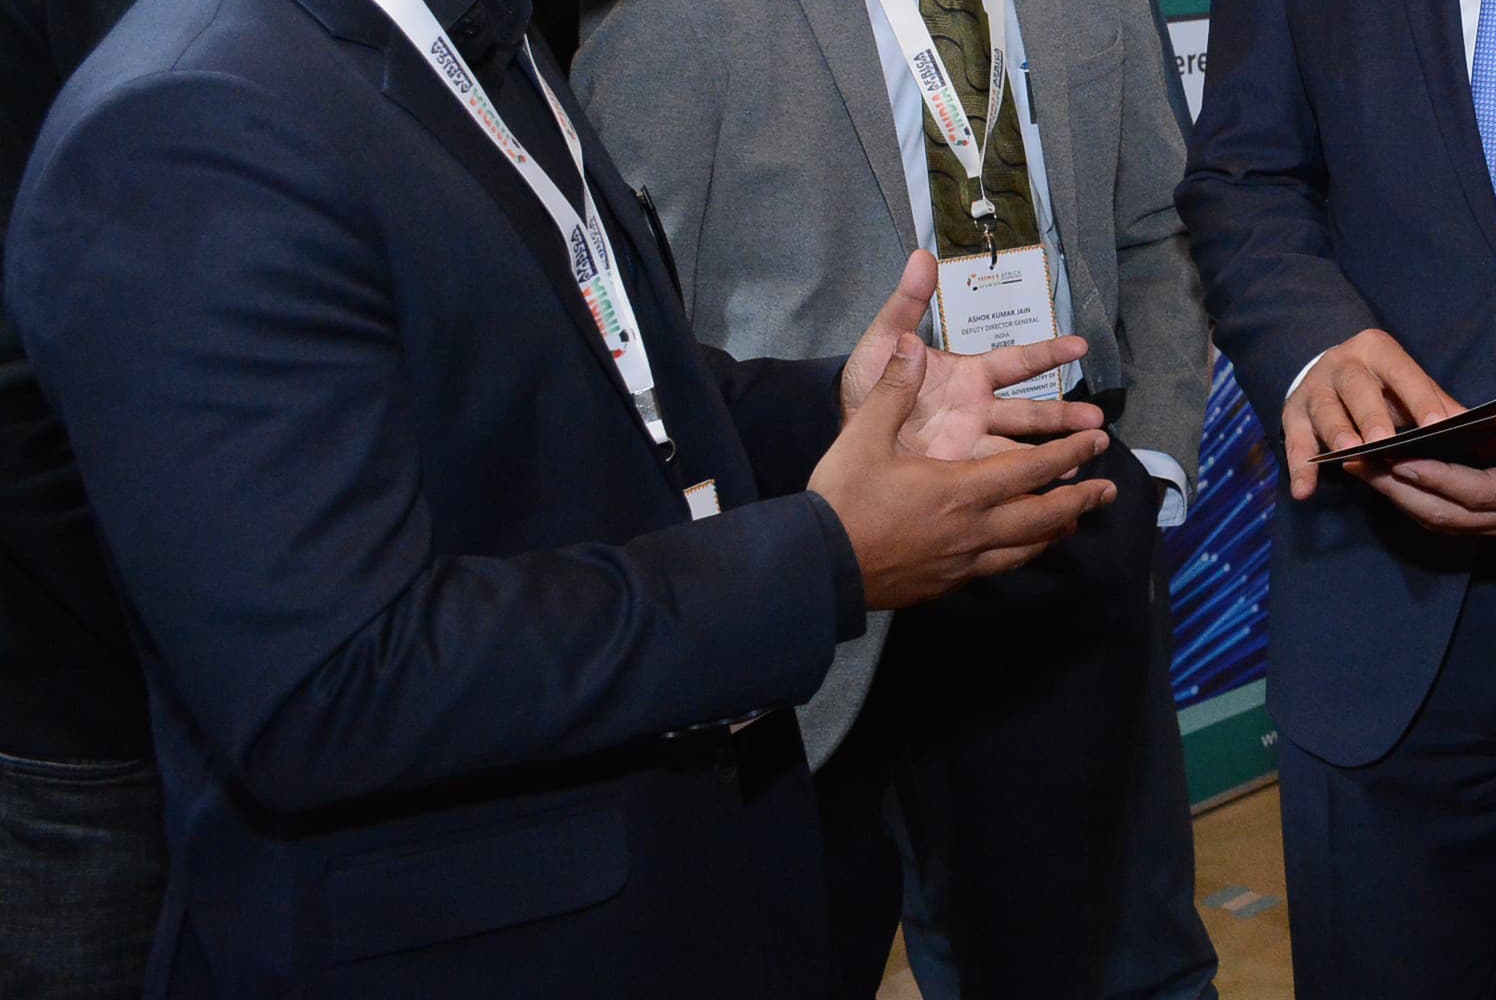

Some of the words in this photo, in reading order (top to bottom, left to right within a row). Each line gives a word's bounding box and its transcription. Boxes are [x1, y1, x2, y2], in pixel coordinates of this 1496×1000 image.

[914, 53, 936, 91] AFRICA
[932, 88, 965, 133] INDIA
[961, 327, 983, 335] DEPUTY
[985, 321, 1013, 331] DIRECTOR
[1014, 316, 1040, 326] GENERAL
[968, 313, 990, 323] ASHOK
[992, 309, 1015, 319] KUMAR
[1017, 307, 1031, 316] JAIN
